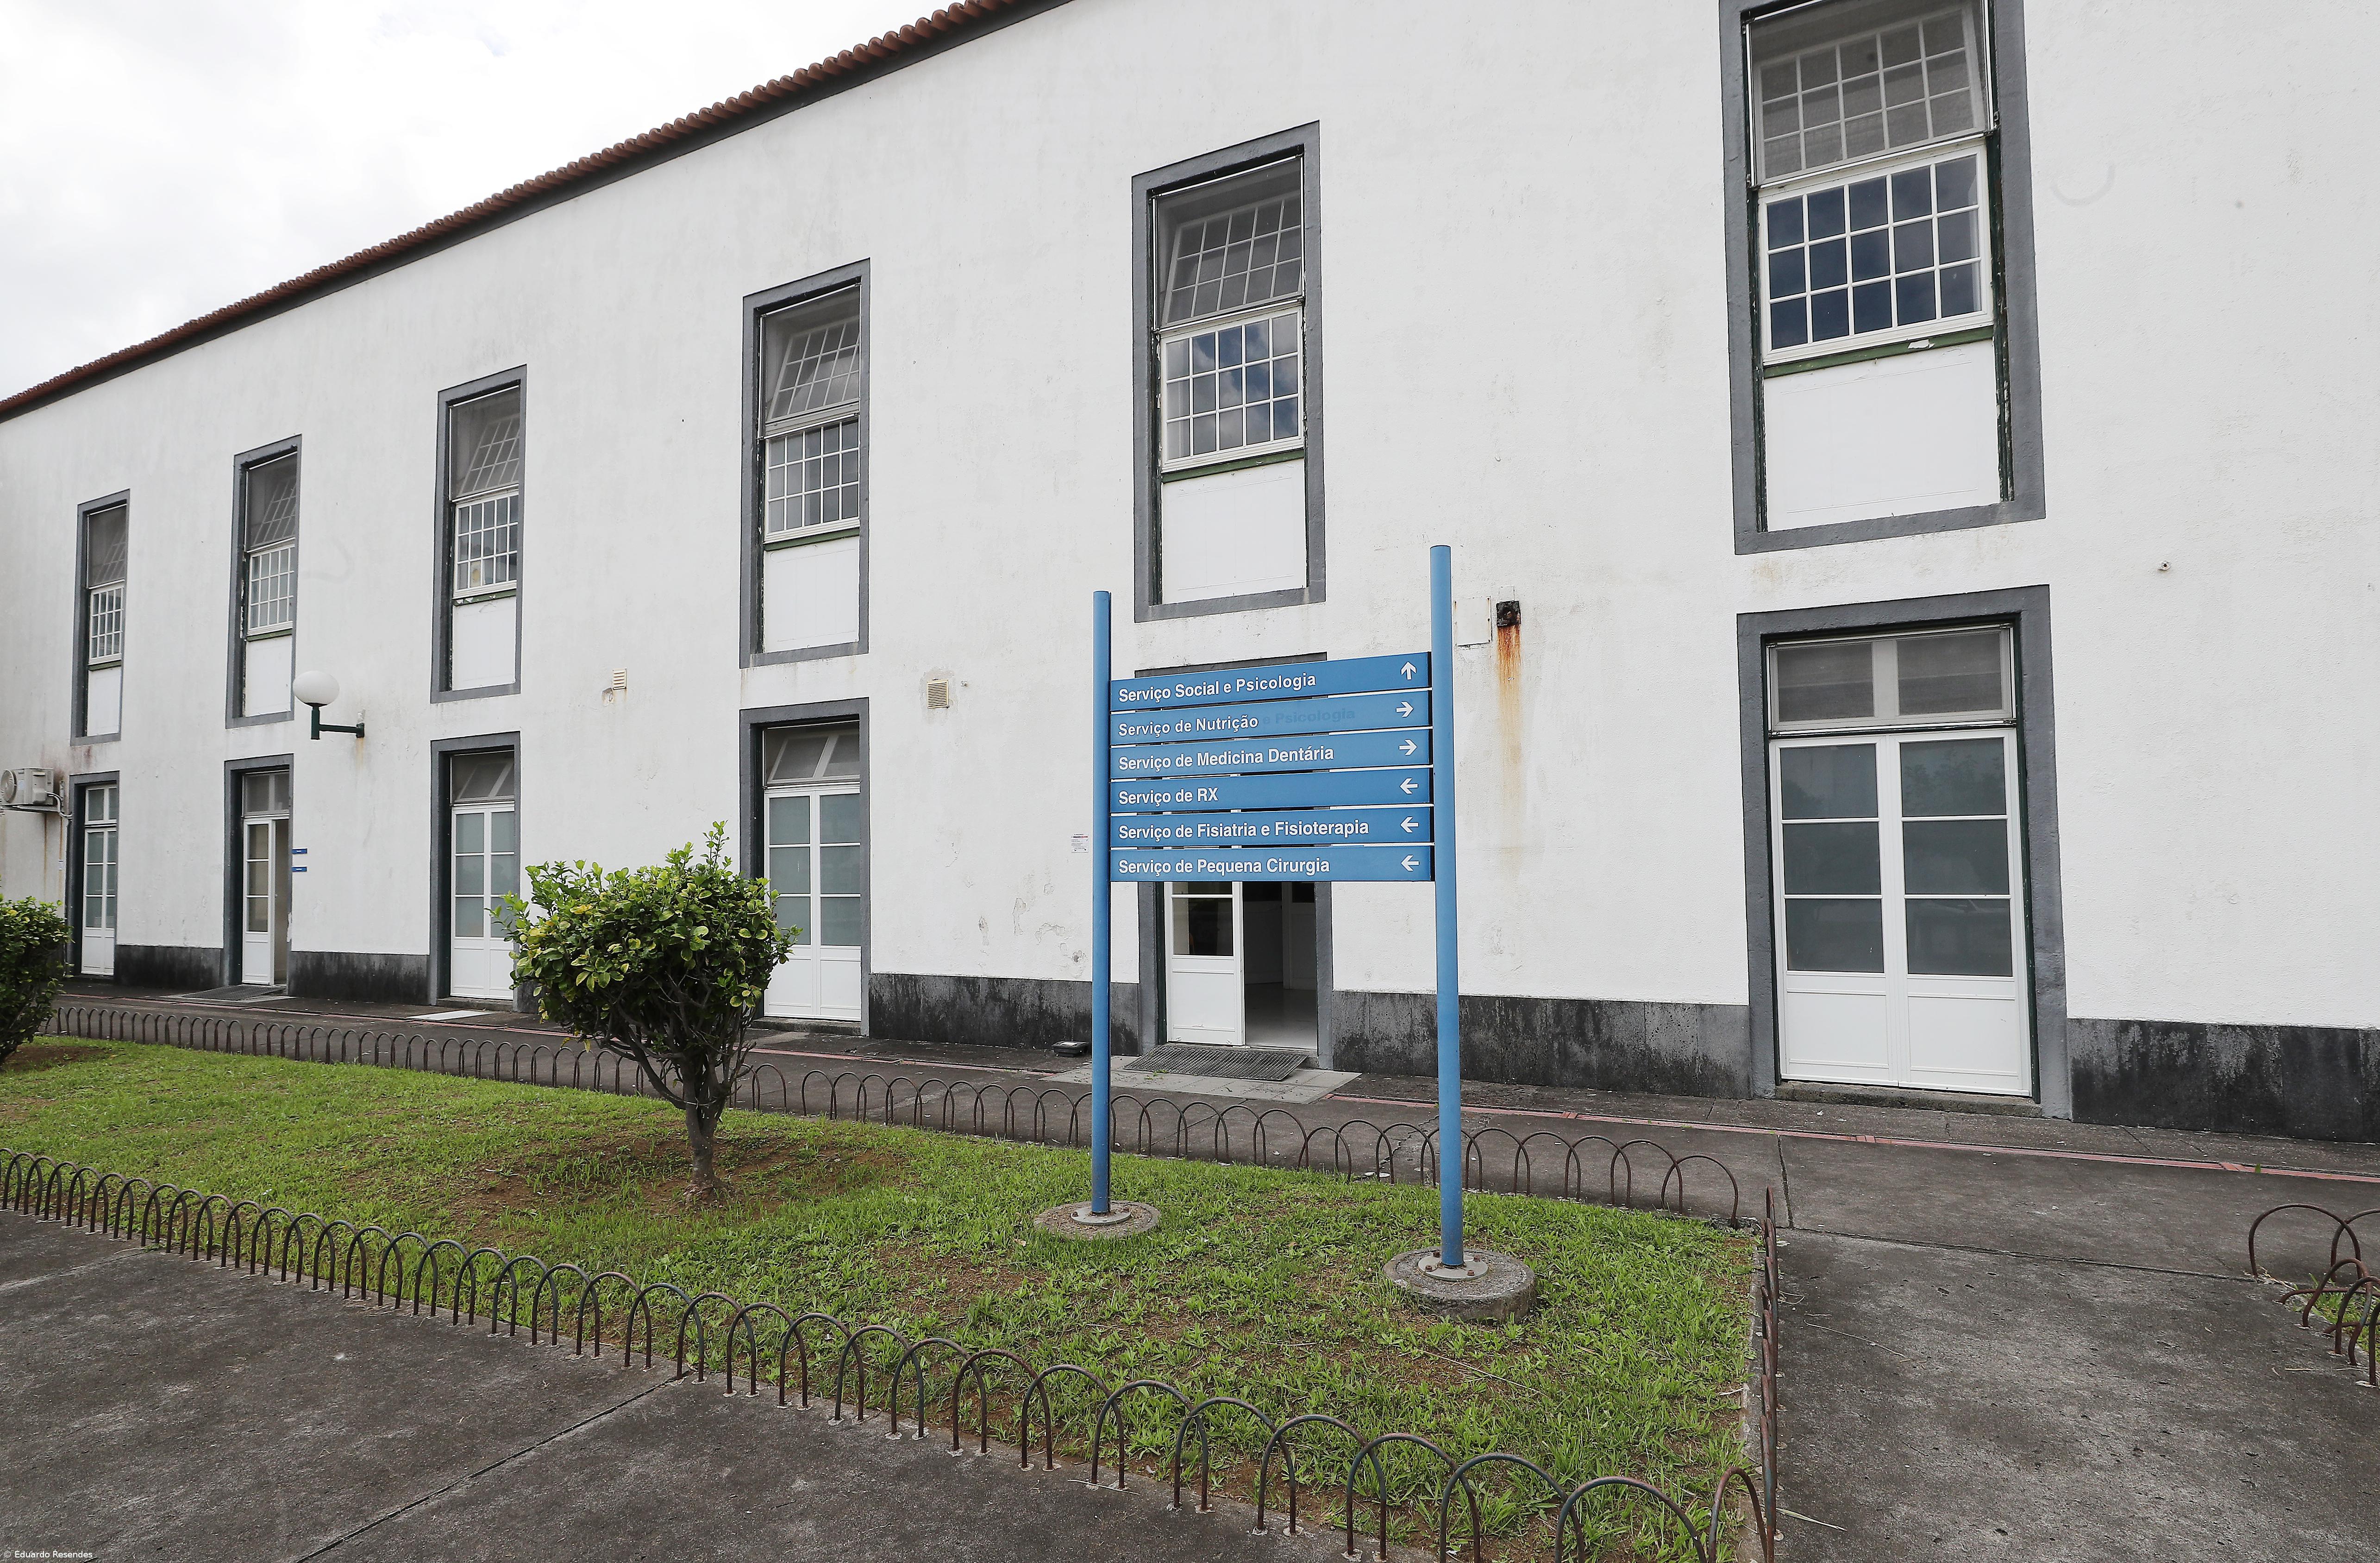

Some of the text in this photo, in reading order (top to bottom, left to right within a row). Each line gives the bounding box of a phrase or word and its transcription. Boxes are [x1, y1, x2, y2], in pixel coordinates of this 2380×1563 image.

[1119, 673, 1316, 703] Serviço Social e Psicologia
[1118, 714, 1258, 738] Serviço de Nutrição
[1263, 708, 1355, 725] e Psicologia
[1119, 745, 1334, 772] Serviço de Medicina Dentária
[1119, 787, 1218, 807] Serviço de RX
[1119, 819, 1369, 842] Serviço de Fisiatria e Fisioterapia
[1119, 857, 1330, 877] Serviço de Pequena Cirurgia
